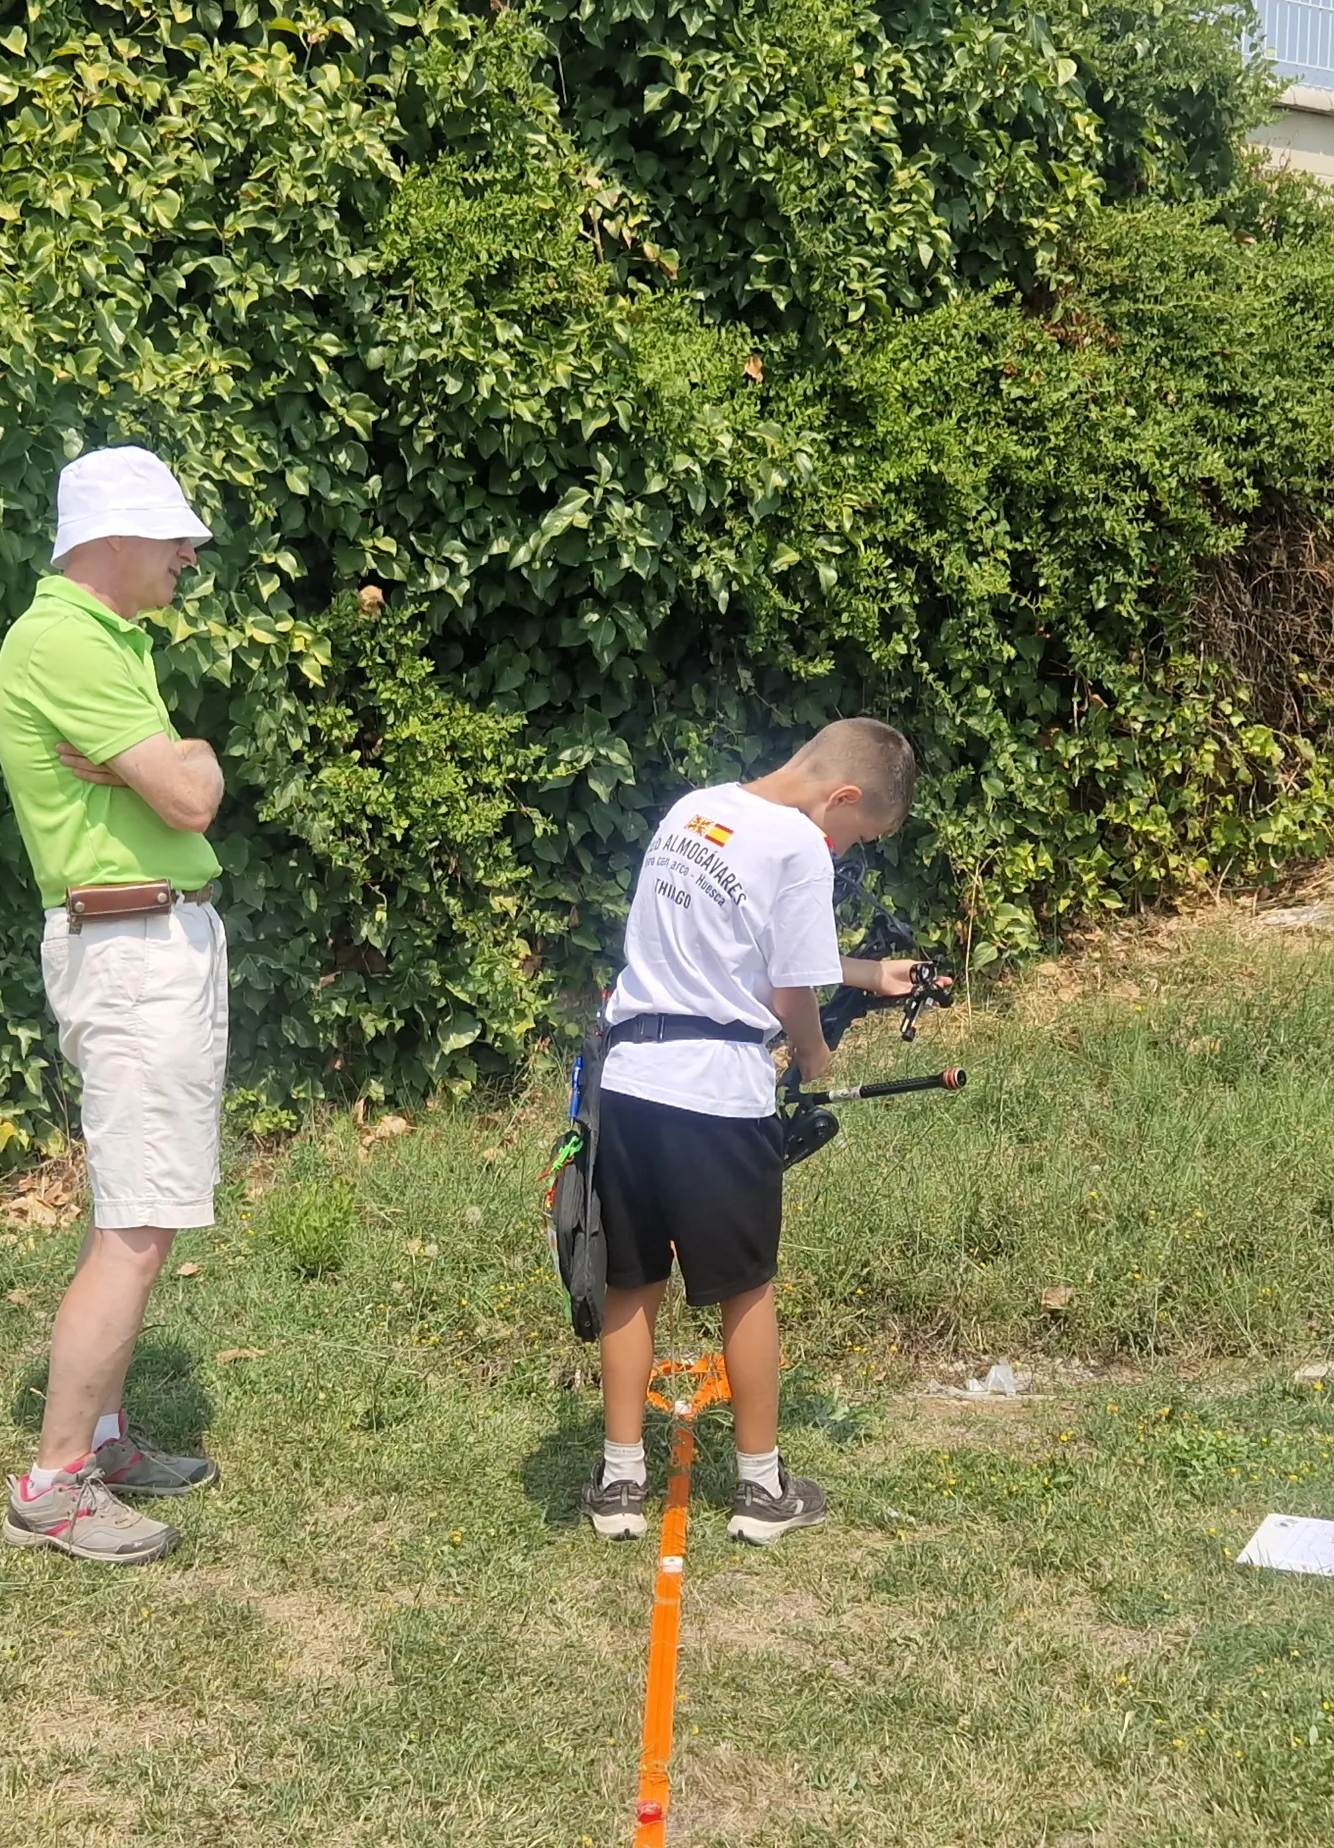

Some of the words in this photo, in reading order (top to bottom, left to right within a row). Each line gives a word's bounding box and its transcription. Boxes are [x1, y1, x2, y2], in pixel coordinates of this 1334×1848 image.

[663, 834, 748, 906] ALMOGÁVARES
[670, 861, 689, 876] arco
[695, 873, 725, 907] Huesca
